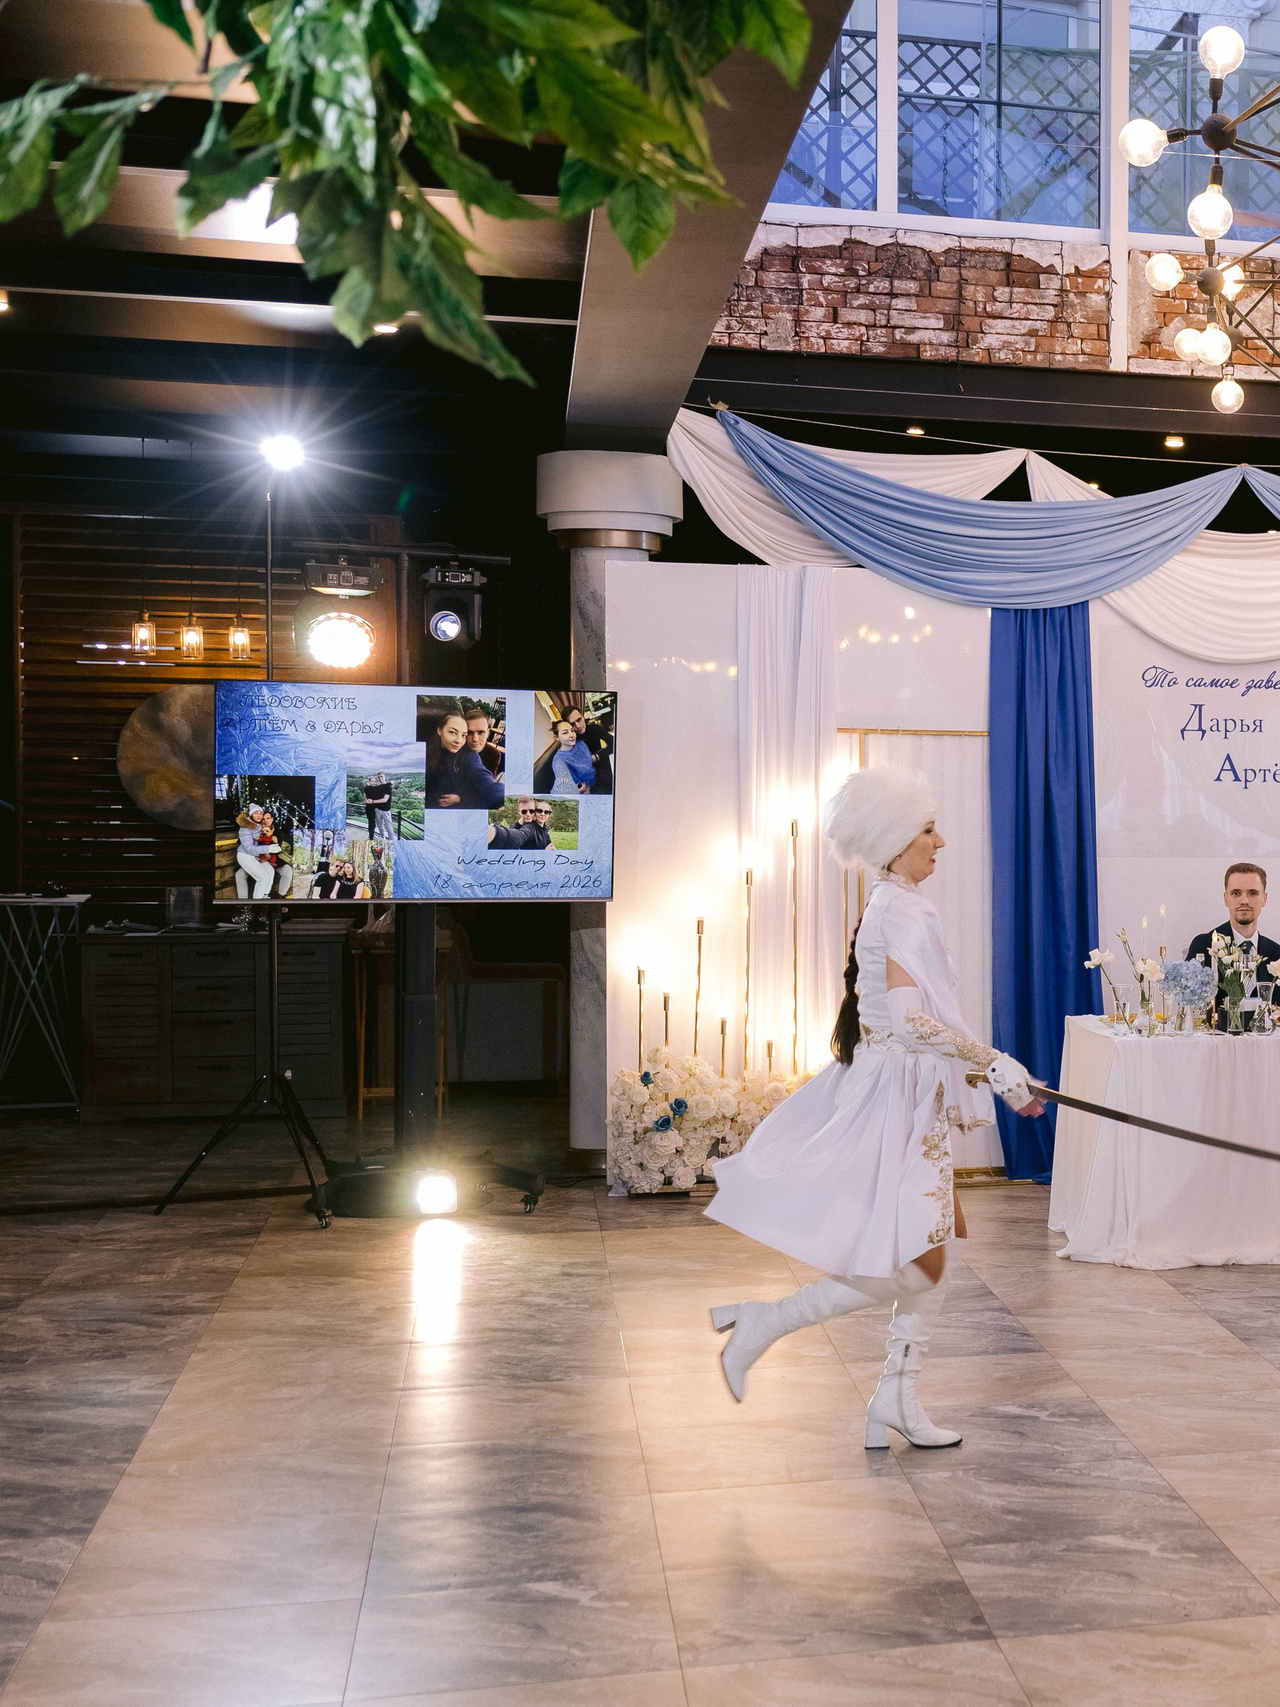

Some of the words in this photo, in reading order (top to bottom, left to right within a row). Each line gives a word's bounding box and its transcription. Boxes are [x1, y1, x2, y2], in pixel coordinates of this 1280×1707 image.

[1141, 664, 1180, 689] То
[1185, 675, 1240, 689] самое
[222, 716, 298, 733] АРТЁМ
[305, 720, 317, 733] &
[324, 720, 385, 737] ДАРЬЯ
[1179, 703, 1265, 741] Дарья
[457, 854, 546, 872] Wedding
[553, 854, 595, 871] Day
[433, 874, 453, 889] 18
[462, 881, 551, 895] апреля
[560, 874, 603, 889] 2026
